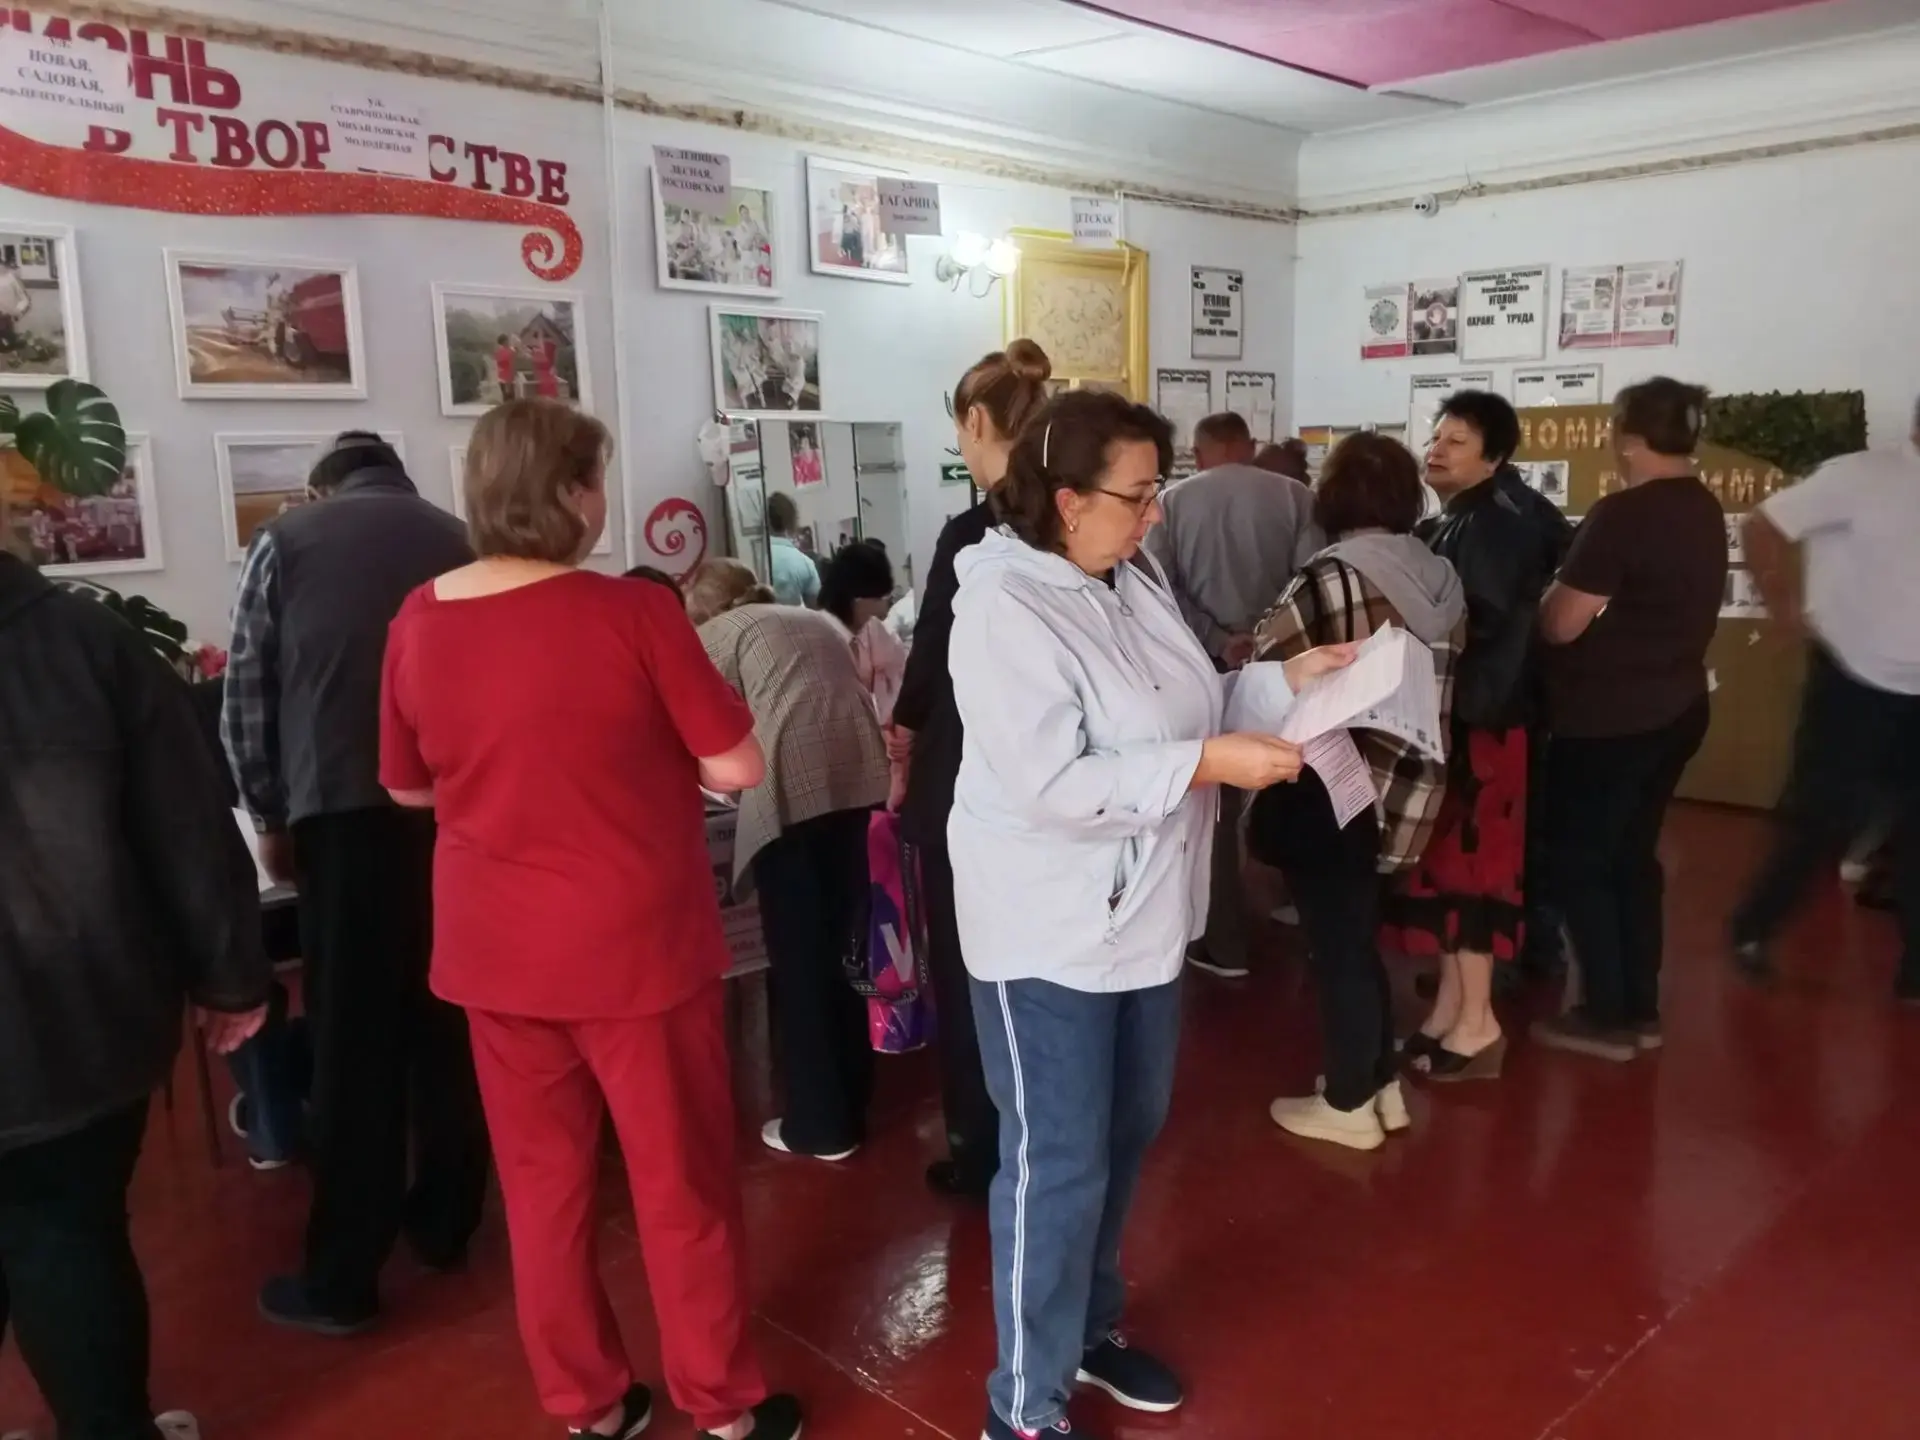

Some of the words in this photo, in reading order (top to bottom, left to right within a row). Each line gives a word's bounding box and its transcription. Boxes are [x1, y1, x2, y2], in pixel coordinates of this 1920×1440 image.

[28, 48, 93, 74] НОВАЯ,
[16, 65, 105, 94] САДОВАЯ,
[879, 193, 938, 209] ГАГАРИНА
[1489, 293, 1518, 306] УГОЛОК
[1507, 312, 1535, 326] ТРУДА
